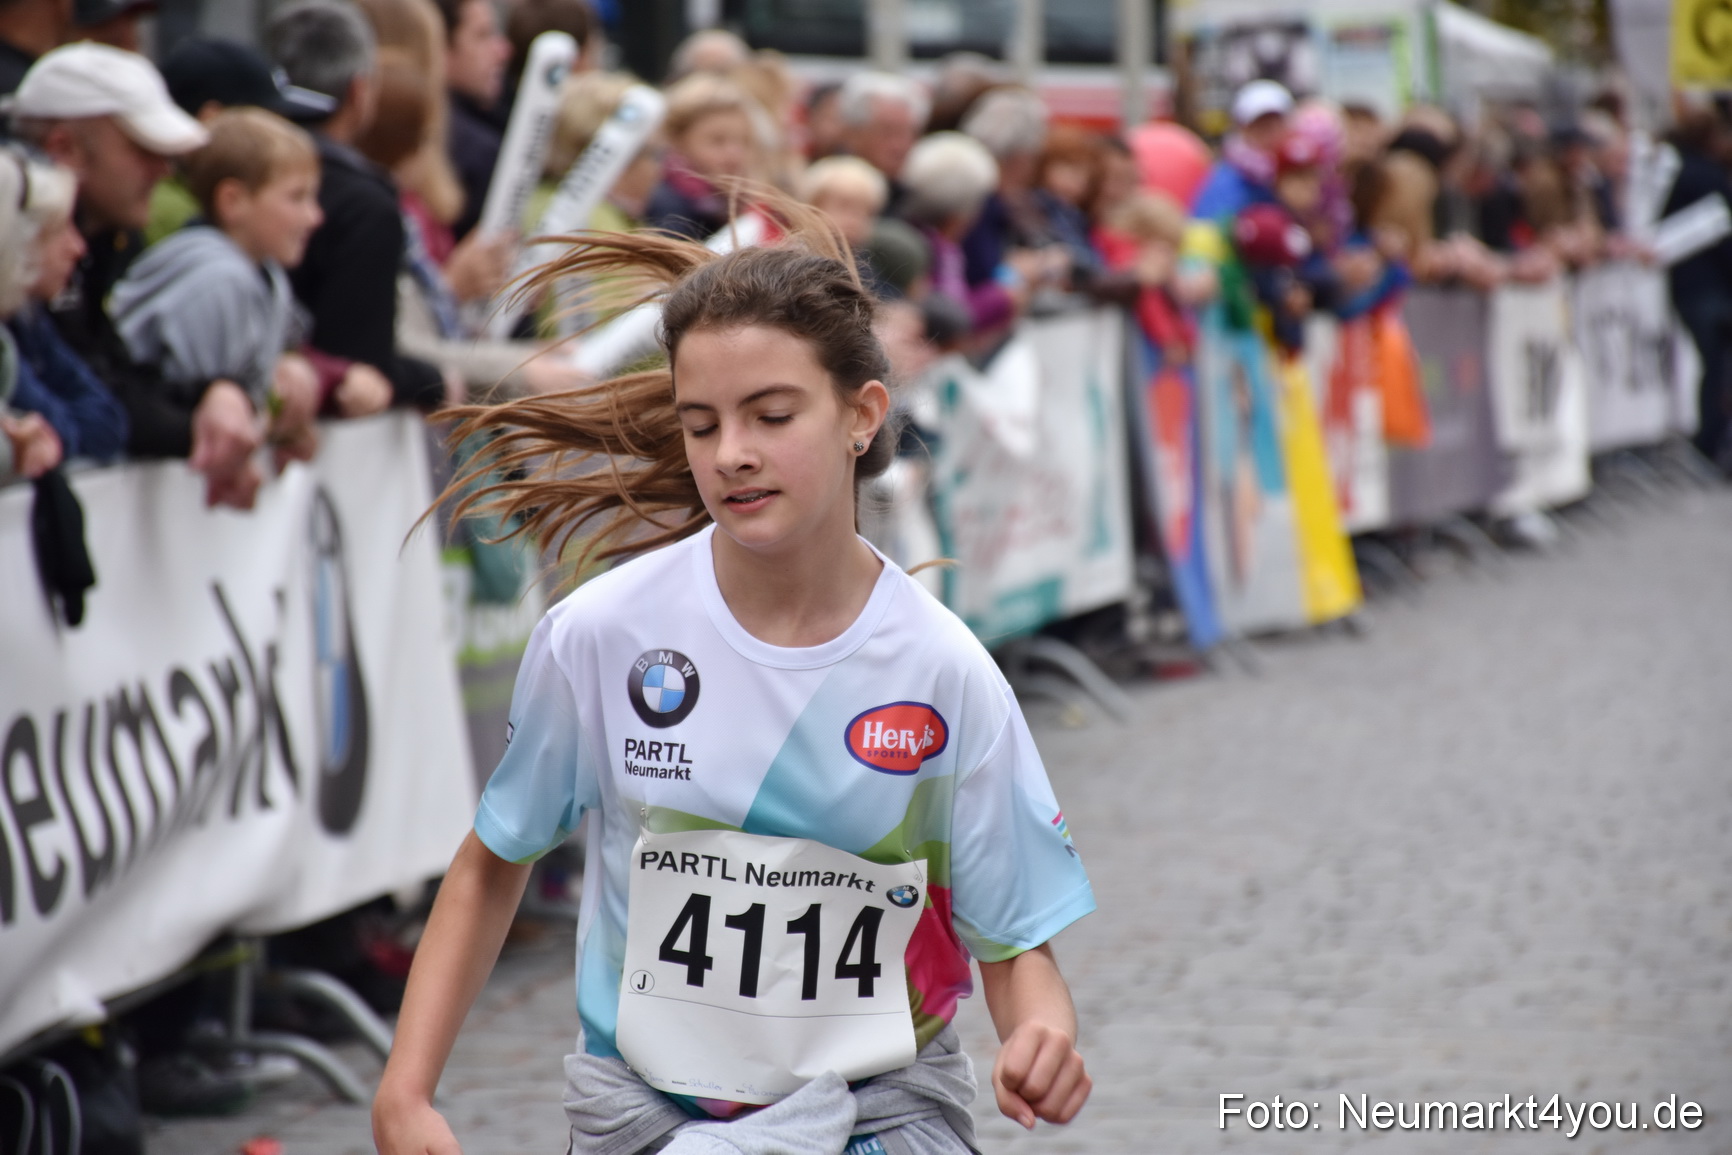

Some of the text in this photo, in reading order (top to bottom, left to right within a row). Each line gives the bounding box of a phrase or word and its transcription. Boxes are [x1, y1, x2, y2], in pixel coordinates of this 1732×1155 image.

[635, 651, 696, 679] BMW
[624, 737, 693, 764] PARTL
[862, 720, 936, 757] Hervis
[866, 749, 909, 759] SPORTS
[624, 759, 692, 781] Neumarkt
[639, 850, 876, 893] PARTL Neumarkt
[658, 892, 885, 1001] 4114
[637, 973, 647, 990] J
